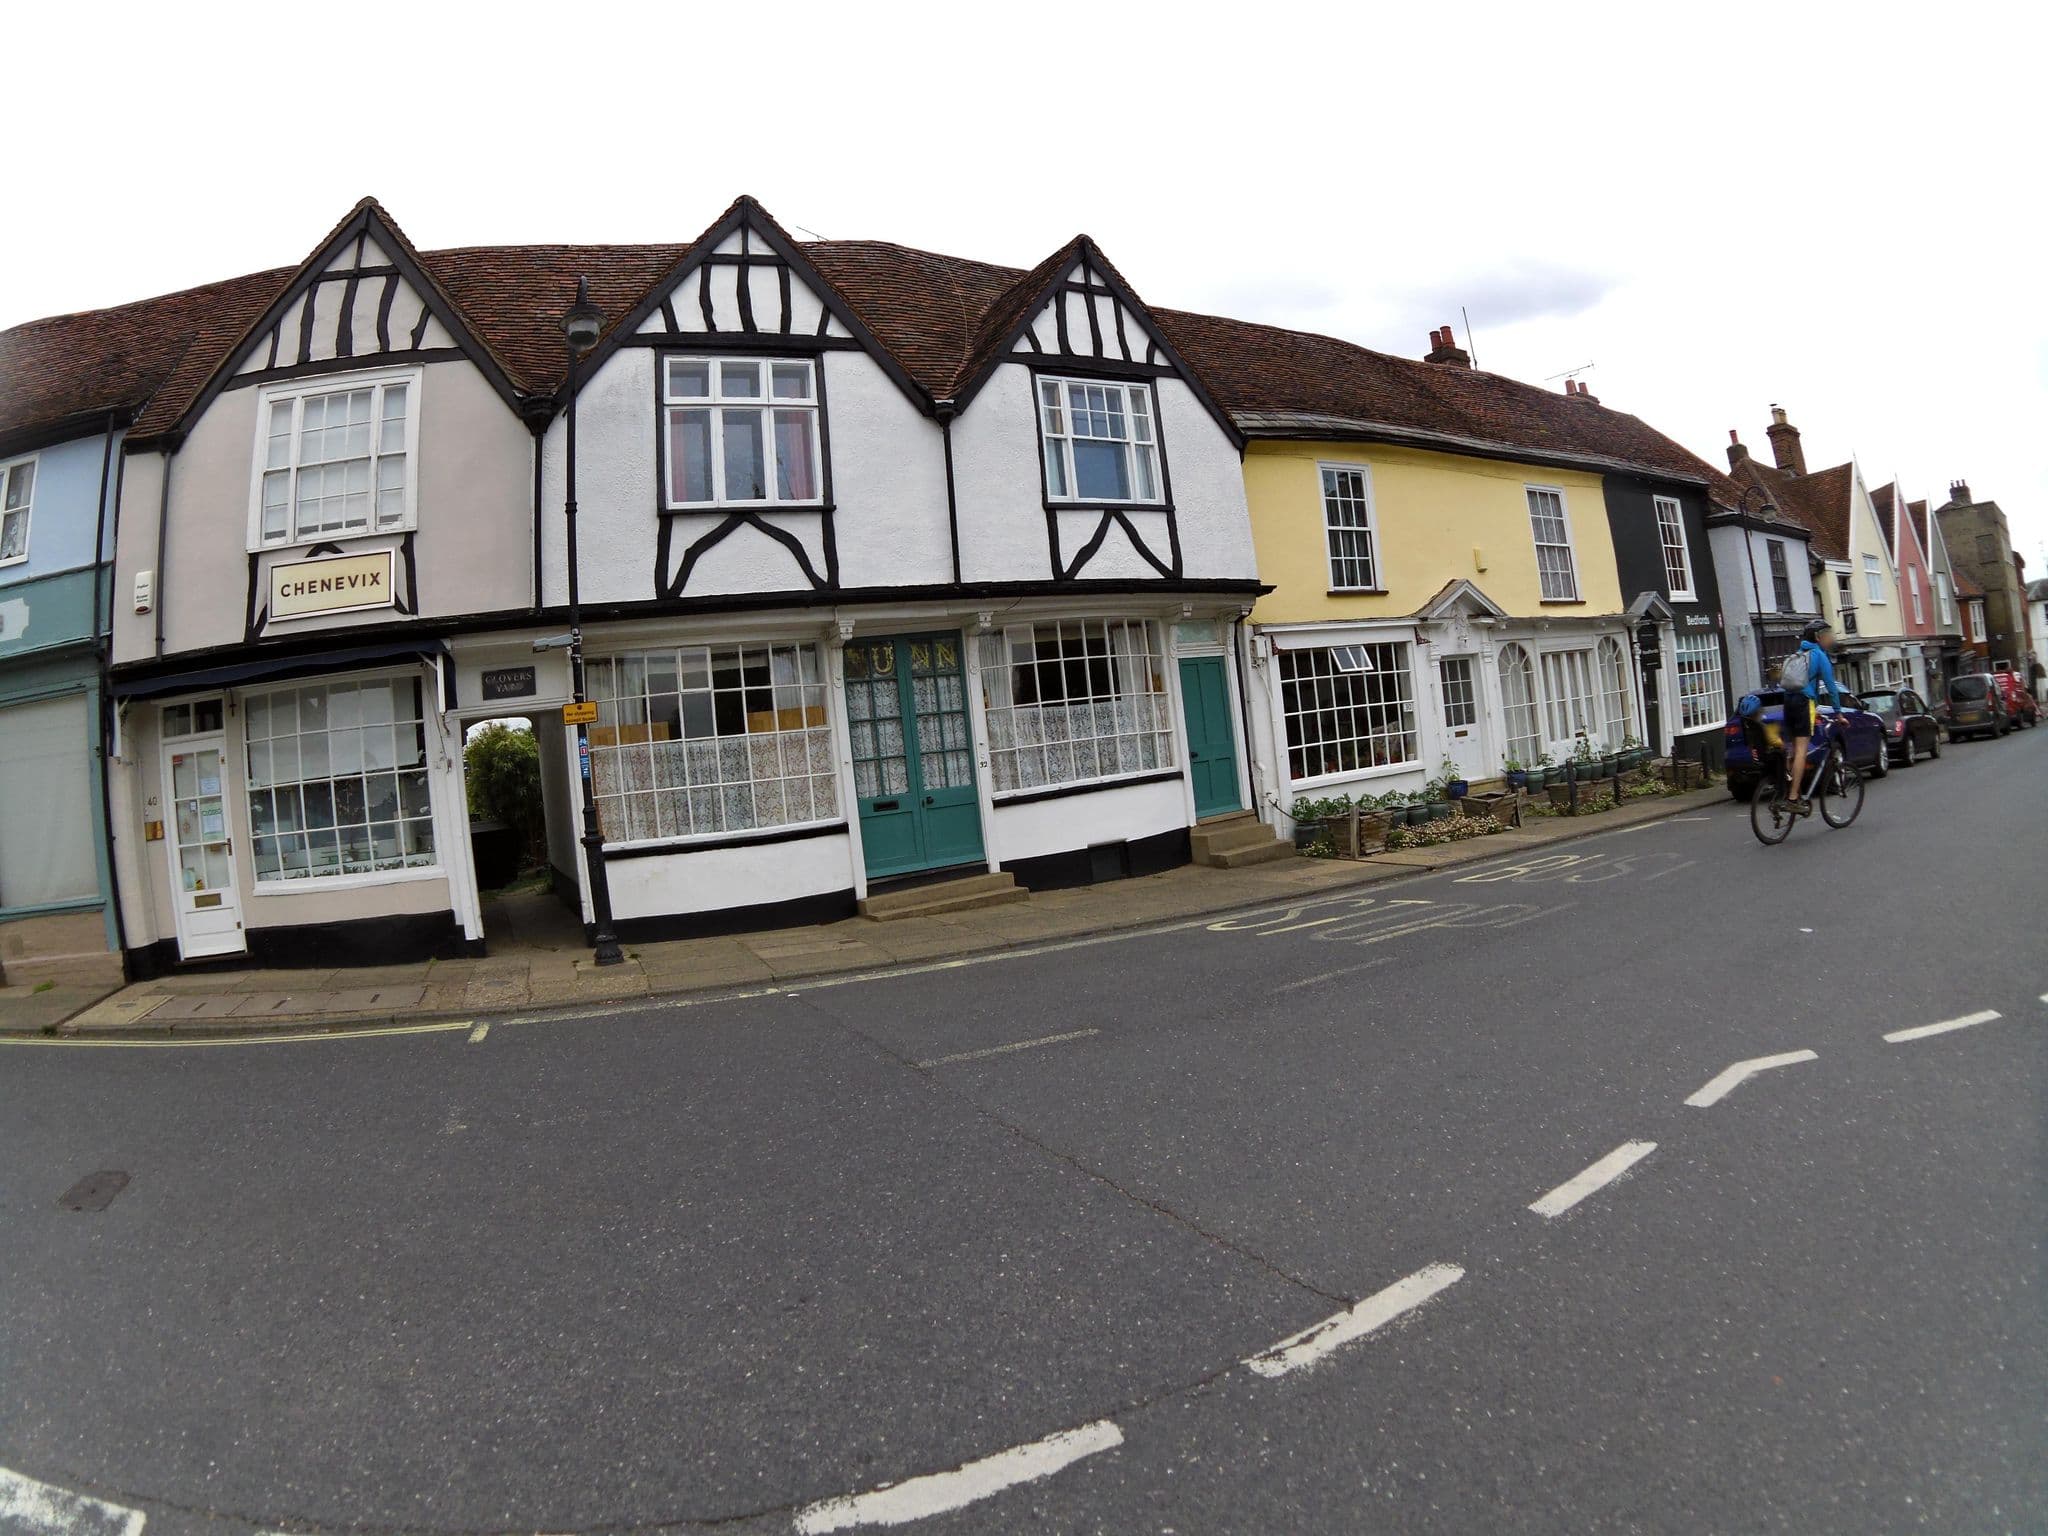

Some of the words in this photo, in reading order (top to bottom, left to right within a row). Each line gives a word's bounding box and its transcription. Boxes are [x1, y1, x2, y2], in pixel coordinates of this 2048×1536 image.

[280, 571, 381, 598] CHENEVIX
[980, 761, 988, 769] 32
[147, 796, 158, 806] 40
[1452, 853, 1680, 884] BUS
[1206, 898, 1540, 945] STOP
